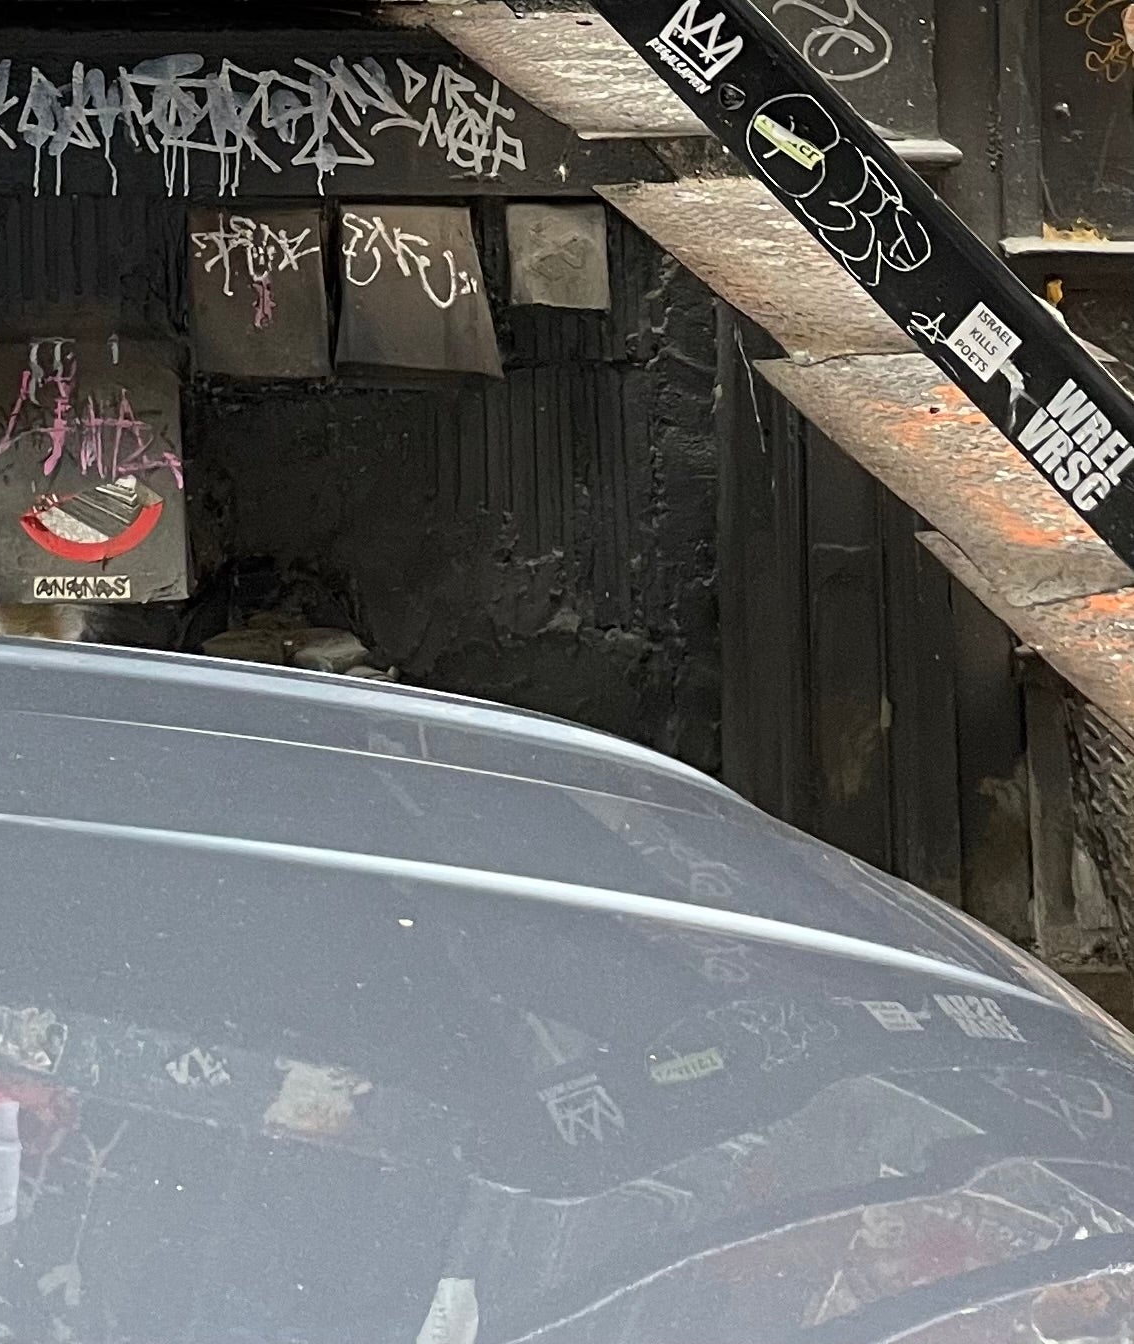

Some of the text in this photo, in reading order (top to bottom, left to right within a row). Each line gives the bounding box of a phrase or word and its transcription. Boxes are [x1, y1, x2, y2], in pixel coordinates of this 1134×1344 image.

[969, 327, 998, 357] KILLS
[977, 309, 1014, 348] ISRAEL
[954, 338, 989, 374] POETS
[1017, 407, 1112, 512] VRSC
